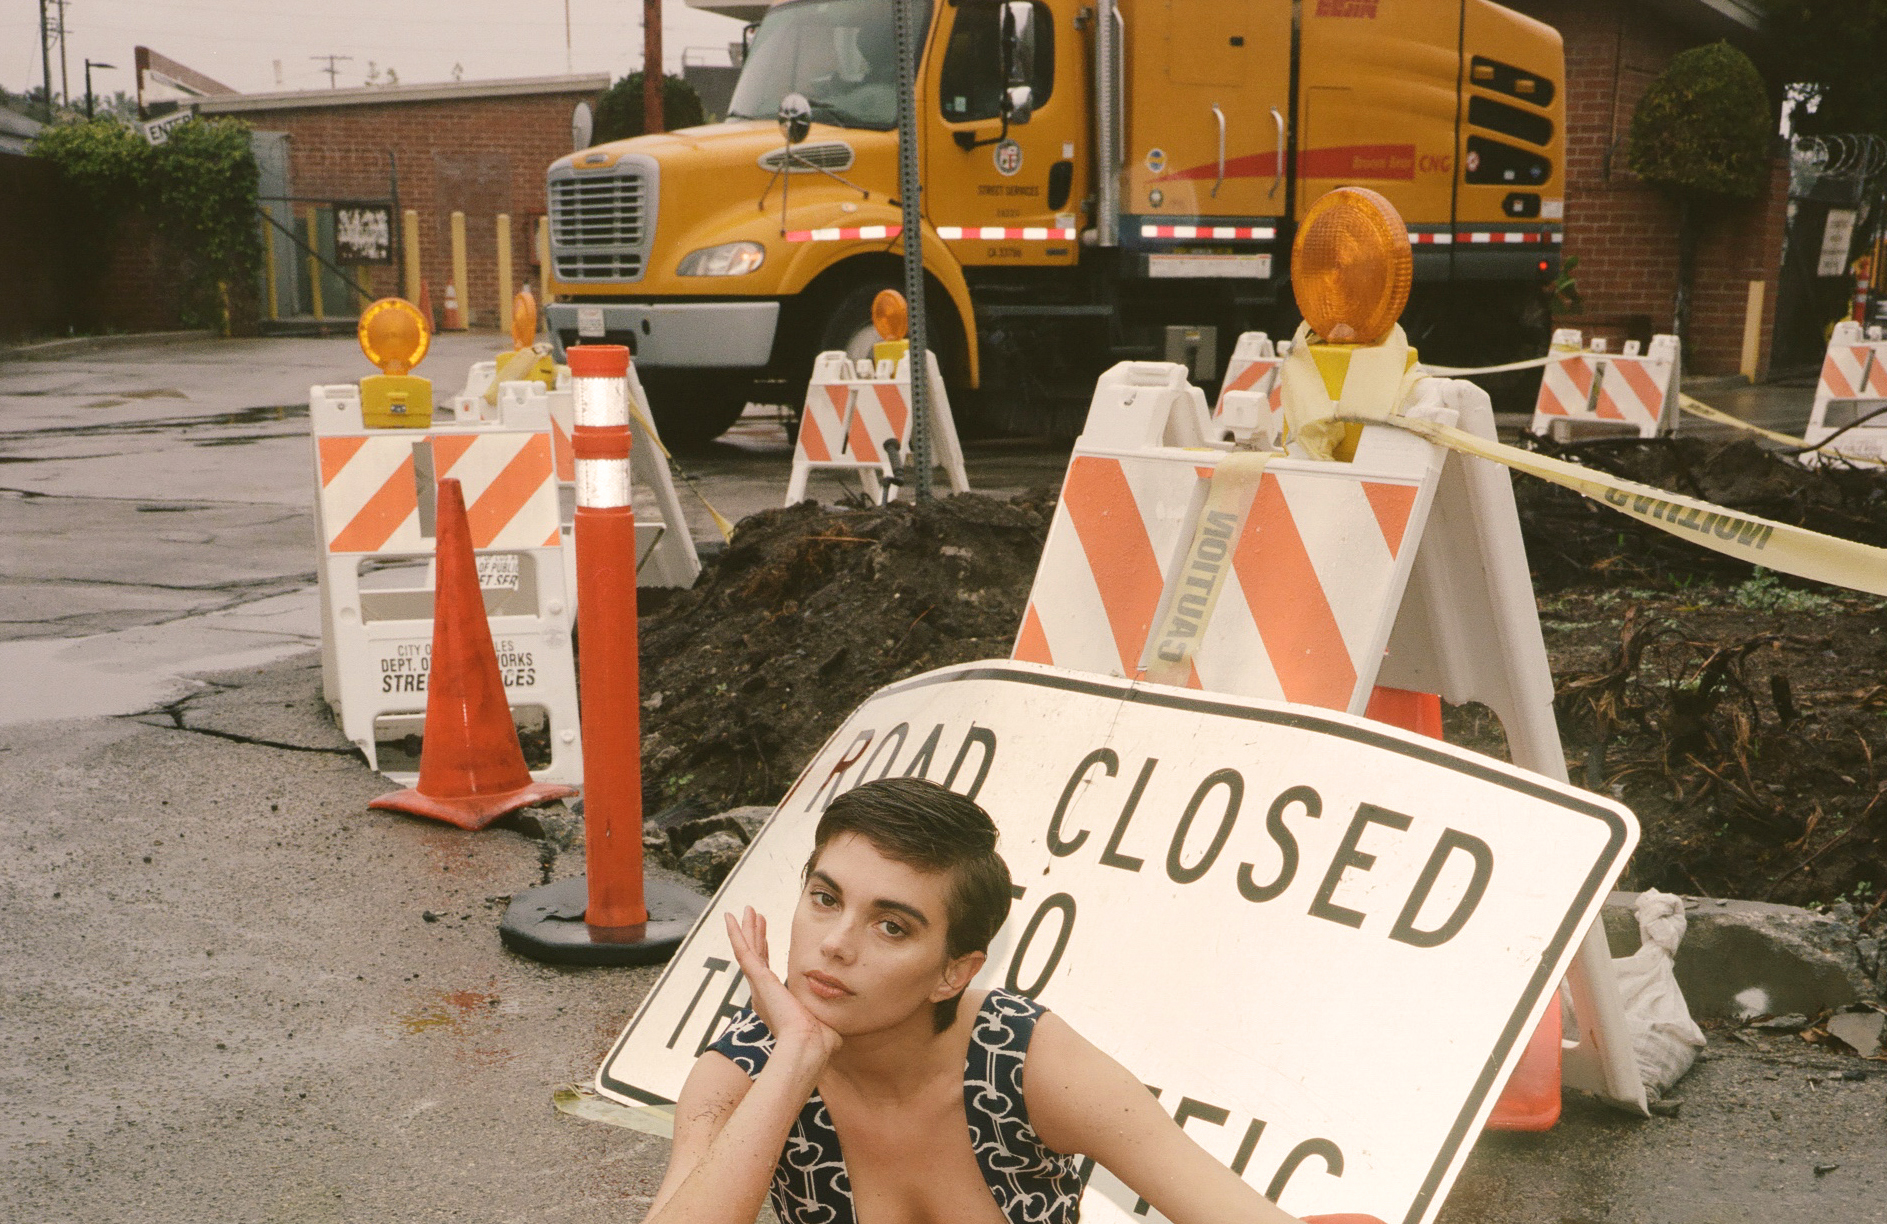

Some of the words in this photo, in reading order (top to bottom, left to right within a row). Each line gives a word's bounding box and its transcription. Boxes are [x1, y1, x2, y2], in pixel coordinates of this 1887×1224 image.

[397, 645, 421, 657] CITY
[381, 658, 417, 673] DEPT.
[421, 657, 432, 671] O
[382, 674, 430, 693] STRE
[804, 721, 997, 813] ROAD
[1046, 747, 1494, 948] CLOSED
